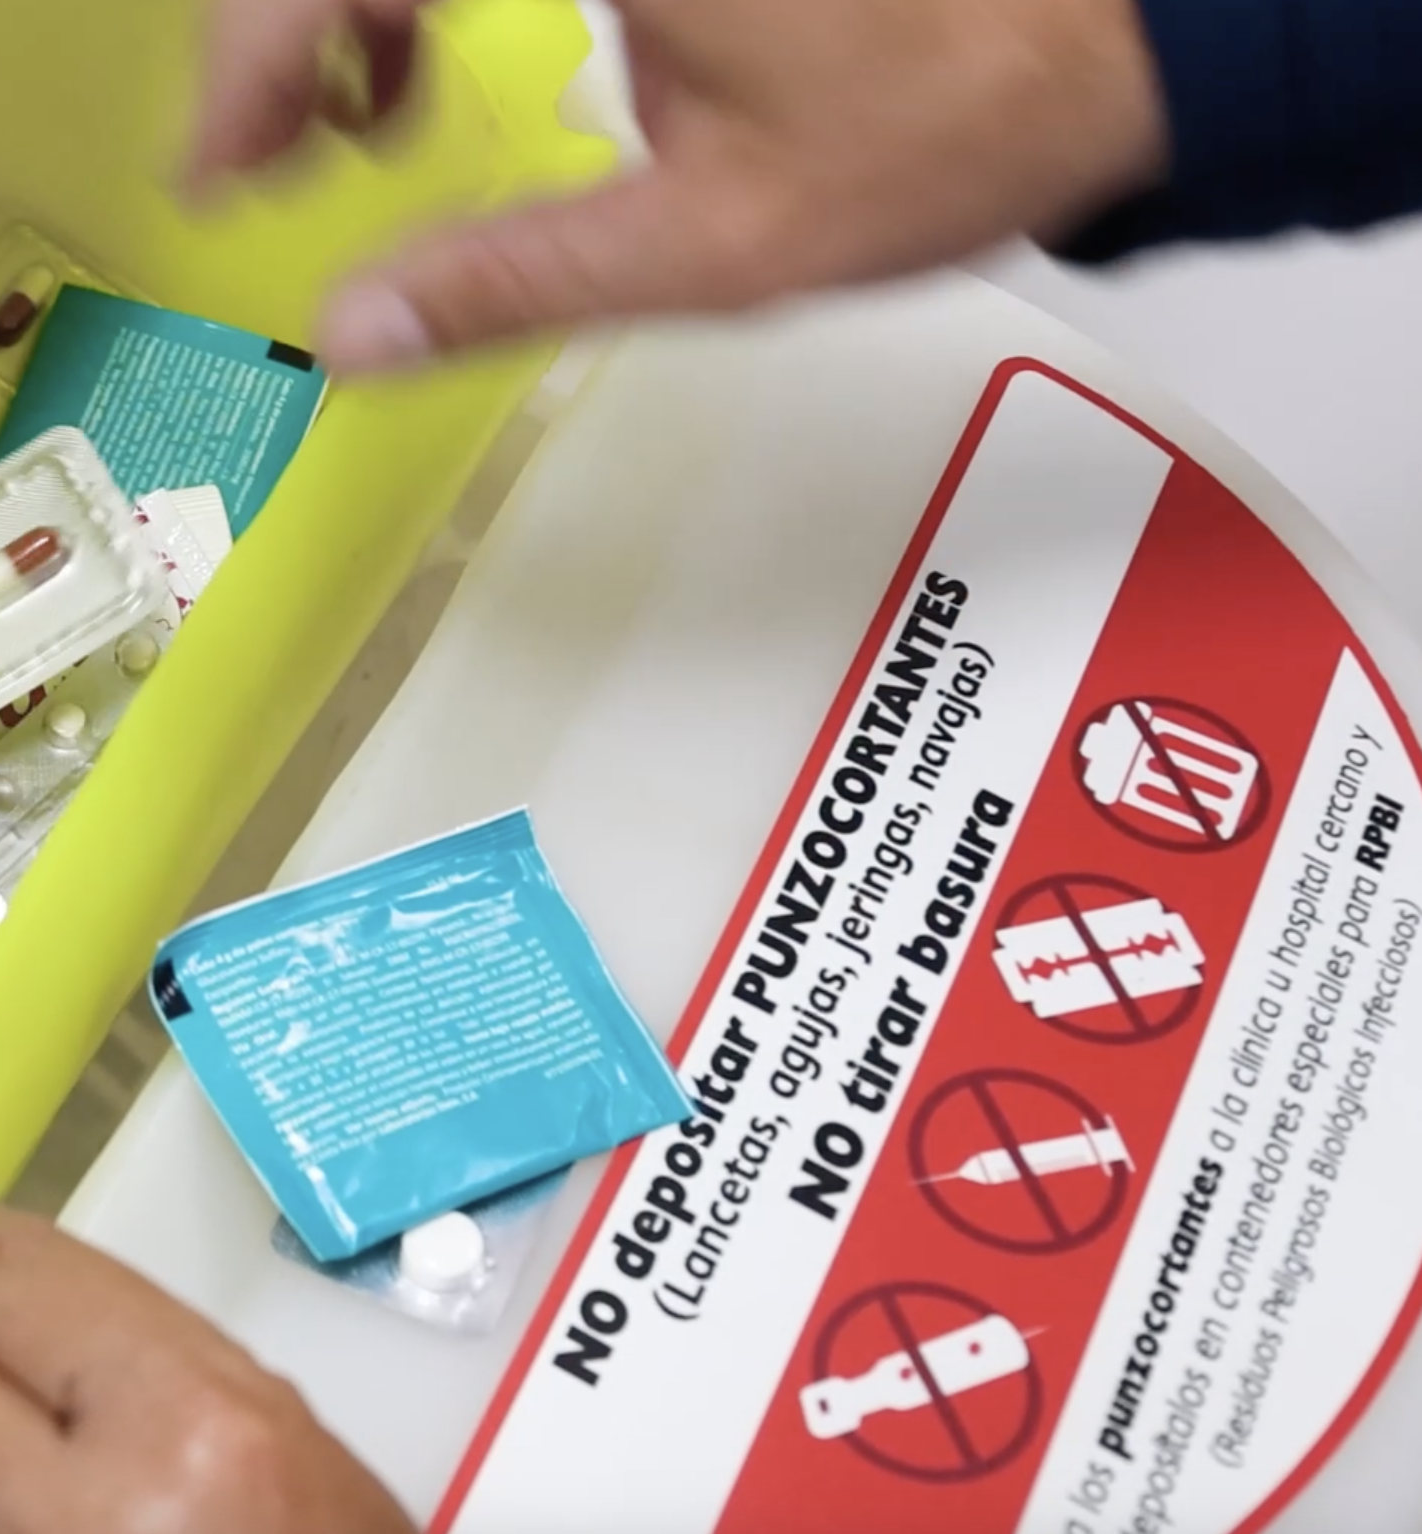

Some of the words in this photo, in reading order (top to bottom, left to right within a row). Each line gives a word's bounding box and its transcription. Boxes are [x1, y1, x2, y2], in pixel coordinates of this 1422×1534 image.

[1351, 724, 1383, 751] y
[1315, 747, 1369, 853] cercano
[1353, 792, 1405, 873] RPBI
[1268, 852, 1331, 967] hospital
[1337, 874, 1379, 947] para
[552, 1289, 629, 1387] NO
[613, 1016, 758, 1281] depositar
[731, 570, 970, 1015] PUNZOCORTANTES
[653, 1115, 789, 1321] (Lancetas,
[769, 966, 857, 1099] agujas,
[825, 802, 932, 965] jeringas,
[908, 641, 995, 791] navajas)
[788, 1121, 865, 1221] NO
[840, 975, 927, 1114] tirar
[896, 788, 1017, 975] basura
[1266, 970, 1292, 992] u
[1287, 945, 1355, 1094] especiales
[1231, 996, 1283, 1088] clínica
[1210, 1129, 1236, 1153] a
[1213, 1093, 1248, 1124] la
[1209, 1327, 1283, 1468] (Residuos
[1259, 1184, 1331, 1323] Peligrosos
[1307, 1046, 1376, 1182] Biológicos
[1354, 898, 1422, 1044] Infecciosos)
[1212, 1098, 1304, 1311] contenedores
[1097, 1157, 1224, 1461] punzocortantes
[1194, 1317, 1227, 1361] en
[1079, 1461, 1116, 1501] los
